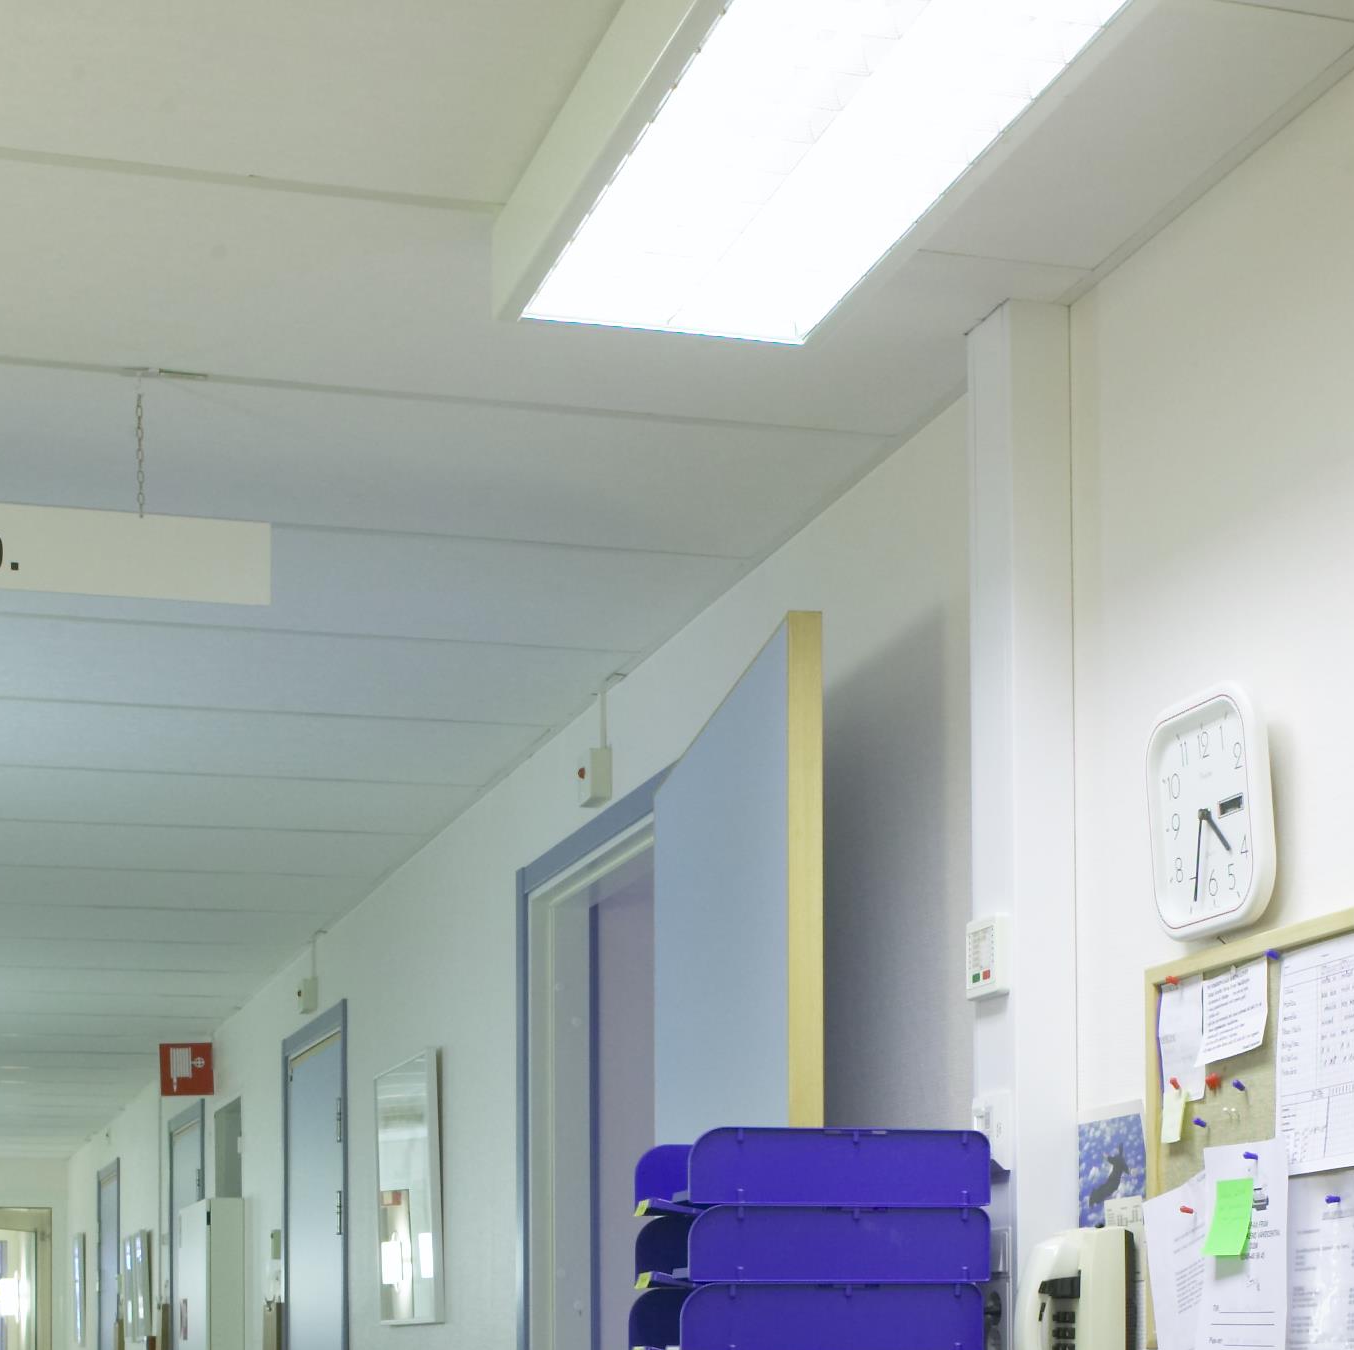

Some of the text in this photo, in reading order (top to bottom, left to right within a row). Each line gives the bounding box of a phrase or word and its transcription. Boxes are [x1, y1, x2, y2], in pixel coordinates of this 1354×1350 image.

[1179, 741, 1189, 767] 11
[1197, 731, 1210, 759] 12
[1232, 742, 1244, 770] 2
[1167, 773, 1181, 800] 10
[1171, 813, 1181, 841] 9
[1240, 834, 1249, 860] 4
[1174, 857, 1184, 884] 8
[1208, 868, 1219, 897] 6
[1227, 862, 1236, 891] 5
